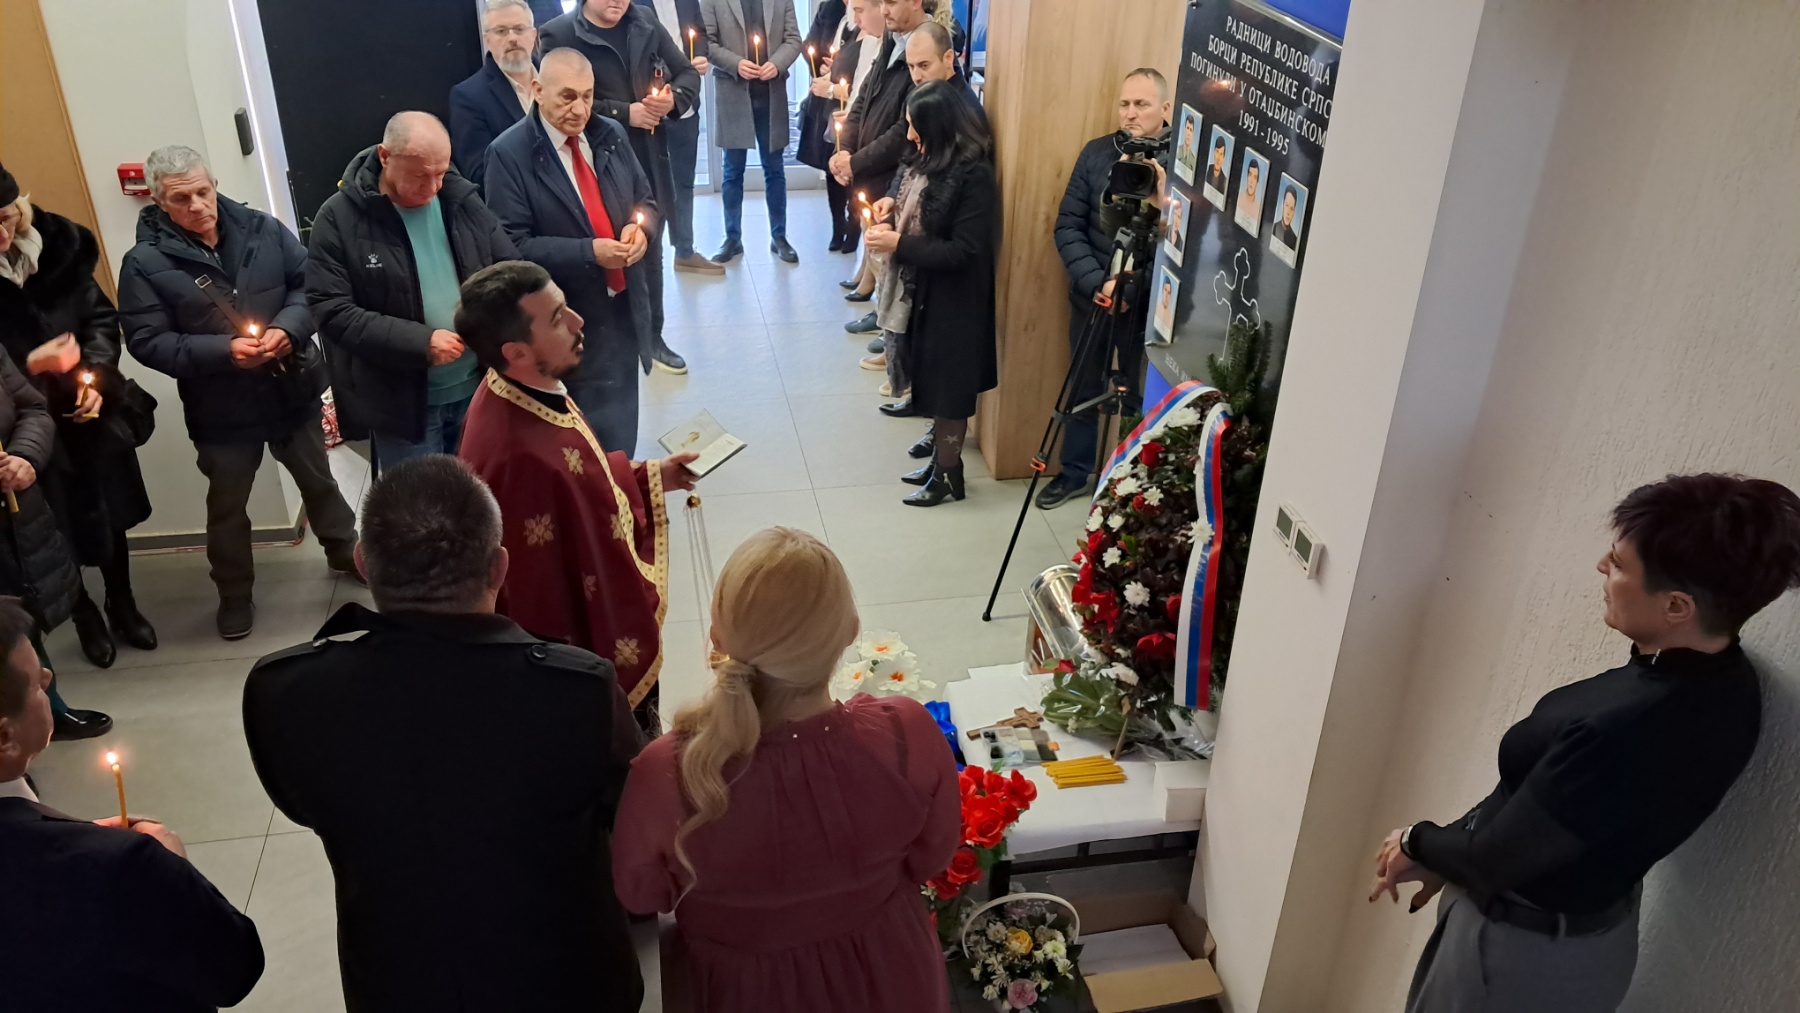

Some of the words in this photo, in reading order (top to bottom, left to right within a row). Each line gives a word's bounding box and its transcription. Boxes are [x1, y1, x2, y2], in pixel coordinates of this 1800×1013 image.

[1191, 51, 1237, 93] ПОГИНУЛИ
[1239, 80, 1247, 98] У
[1208, 34, 1238, 65] БОРЦИ
[1240, 52, 1299, 100] РЕПУБЛИКЕ
[1302, 86, 1333, 119] СРПС
[1226, 16, 1272, 54] РАДНИЦИ
[1275, 40, 1331, 86] ВОДОВОДА
